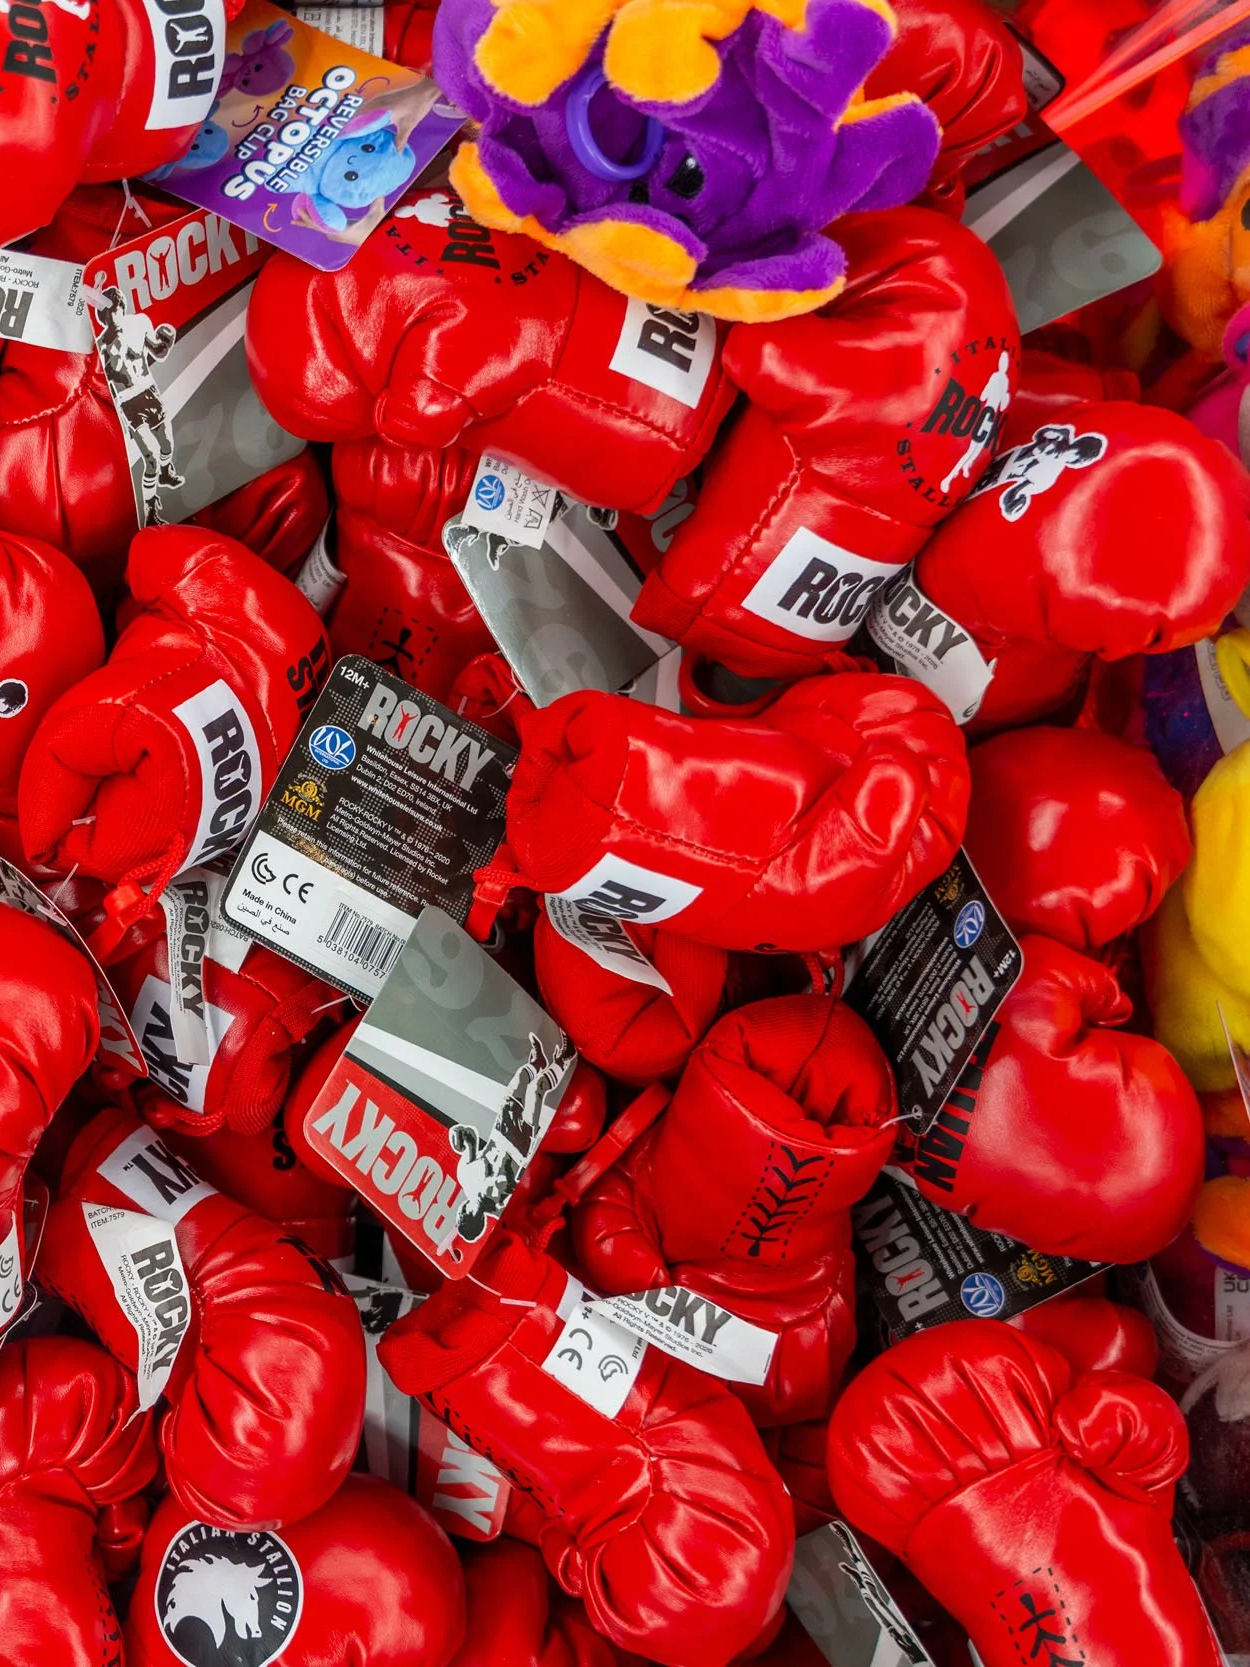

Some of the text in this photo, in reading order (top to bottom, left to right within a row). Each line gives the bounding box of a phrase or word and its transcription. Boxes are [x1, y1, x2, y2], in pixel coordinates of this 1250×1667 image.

[222, 64, 358, 201] OCTOPUS
[231, 83, 308, 162] BAG CLIP
[266, 95, 364, 193] REVERSIBLE
[12, 276, 39, 288] ROCKY
[66, 267, 82, 307] ITEM:7579
[920, 377, 1008, 454] ROCK
[897, 439, 966, 508] STALL
[778, 557, 884, 628] ROC
[337, 664, 373, 690] 12M+
[357, 682, 497, 792] ROCKY
[201, 708, 252, 866] ROCK
[354, 763, 375, 779] Dublin
[359, 754, 453, 812] Basildon, Essex, UK
[364, 744, 478, 815] Whitehouse Leisure International Ltd
[278, 789, 324, 822] MGM
[324, 821, 355, 843] Licensing
[348, 774, 445, 832] www.whitehouseleisure.co.uk
[276, 816, 297, 833] Please
[314, 838, 329, 850] this
[326, 846, 362, 870] information
[361, 865, 372, 875] for
[370, 871, 390, 886] future
[329, 813, 449, 885] All Rights Reserved. Licensed by Rocket
[332, 805, 437, 868] Metro-Goldwyn-Mayer Studios Inc.
[241, 888, 298, 925] Made in China
[354, 874, 375, 890] before
[176, 881, 210, 1021] ROCKY
[991, 946, 1017, 982] 12M+
[917, 957, 995, 1098] ROCKY
[311, 1080, 466, 1247] ROCKY
[89, 1210, 126, 1229] ITEM:7579
[858, 1194, 953, 1323] ROCKY
[119, 1292, 129, 1304] All
[123, 1302, 140, 1325] Rights
[130, 1238, 191, 1375] ROCKY
[620, 1315, 647, 1333] Rights
[663, 1333, 692, 1350] Studios
[166, 1526, 236, 1573] ITALIAN
[247, 1530, 293, 1630] STALLION
